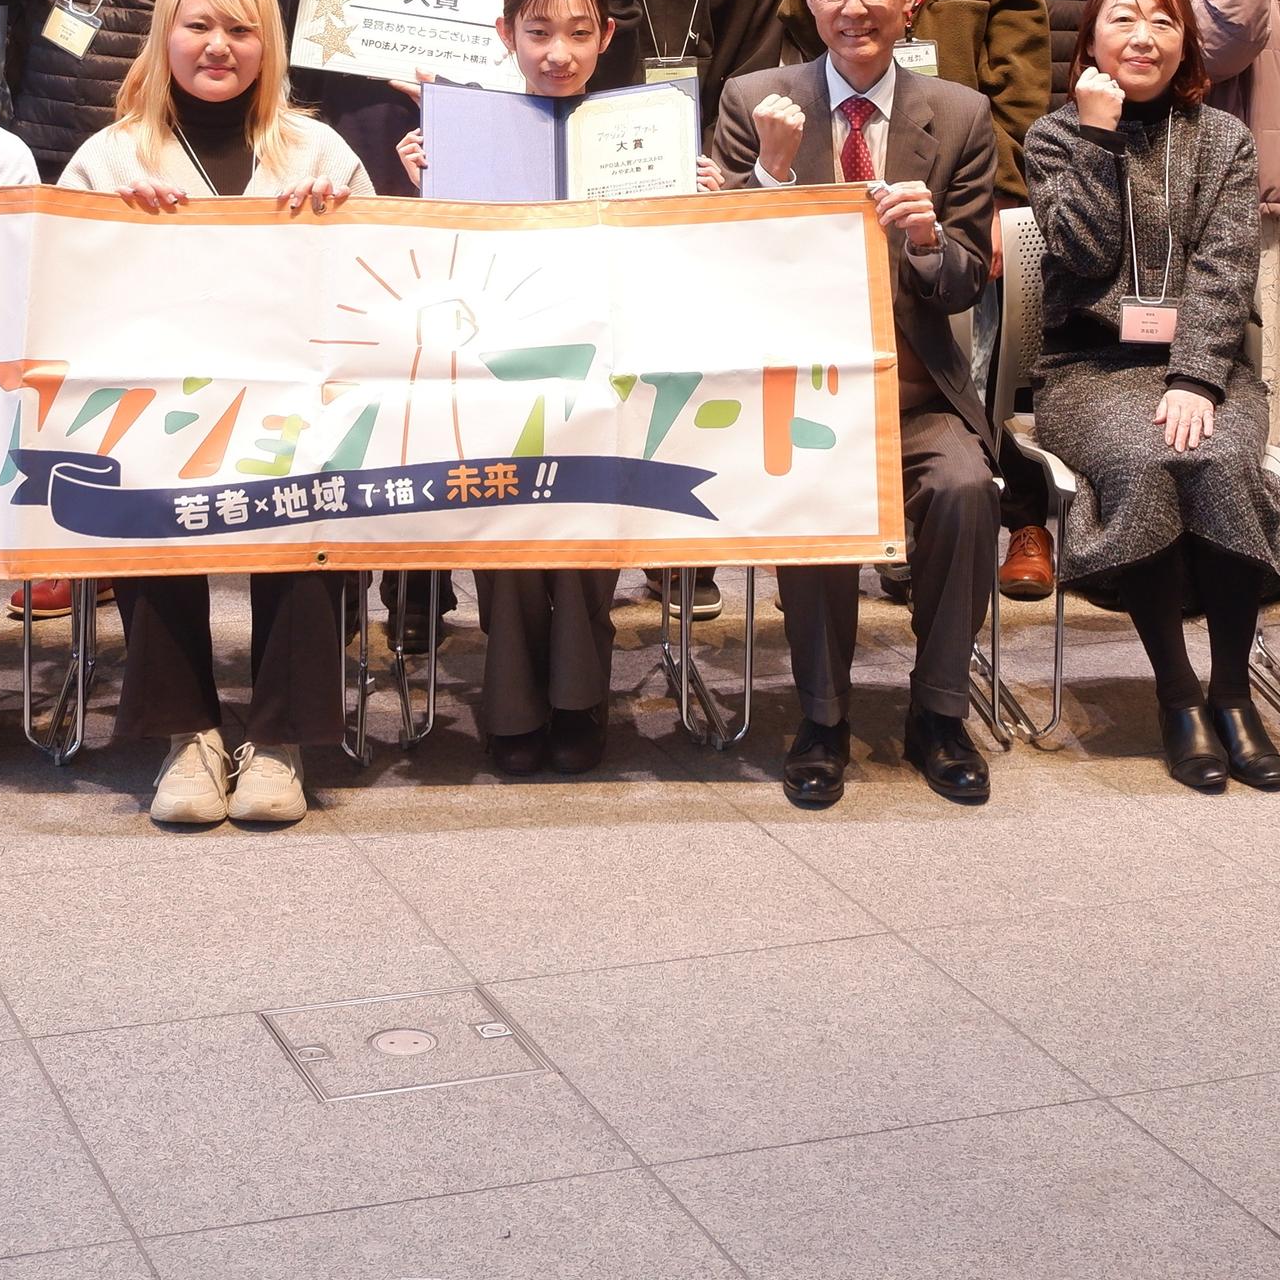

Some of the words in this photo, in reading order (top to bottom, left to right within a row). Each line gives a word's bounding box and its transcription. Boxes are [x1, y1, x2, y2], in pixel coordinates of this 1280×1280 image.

[362, 18, 493, 47] 受賞おめでとうございます
[361, 38, 488, 65] NPO法人アクションポート横浜
[616, 138, 644, 152] 大賞
